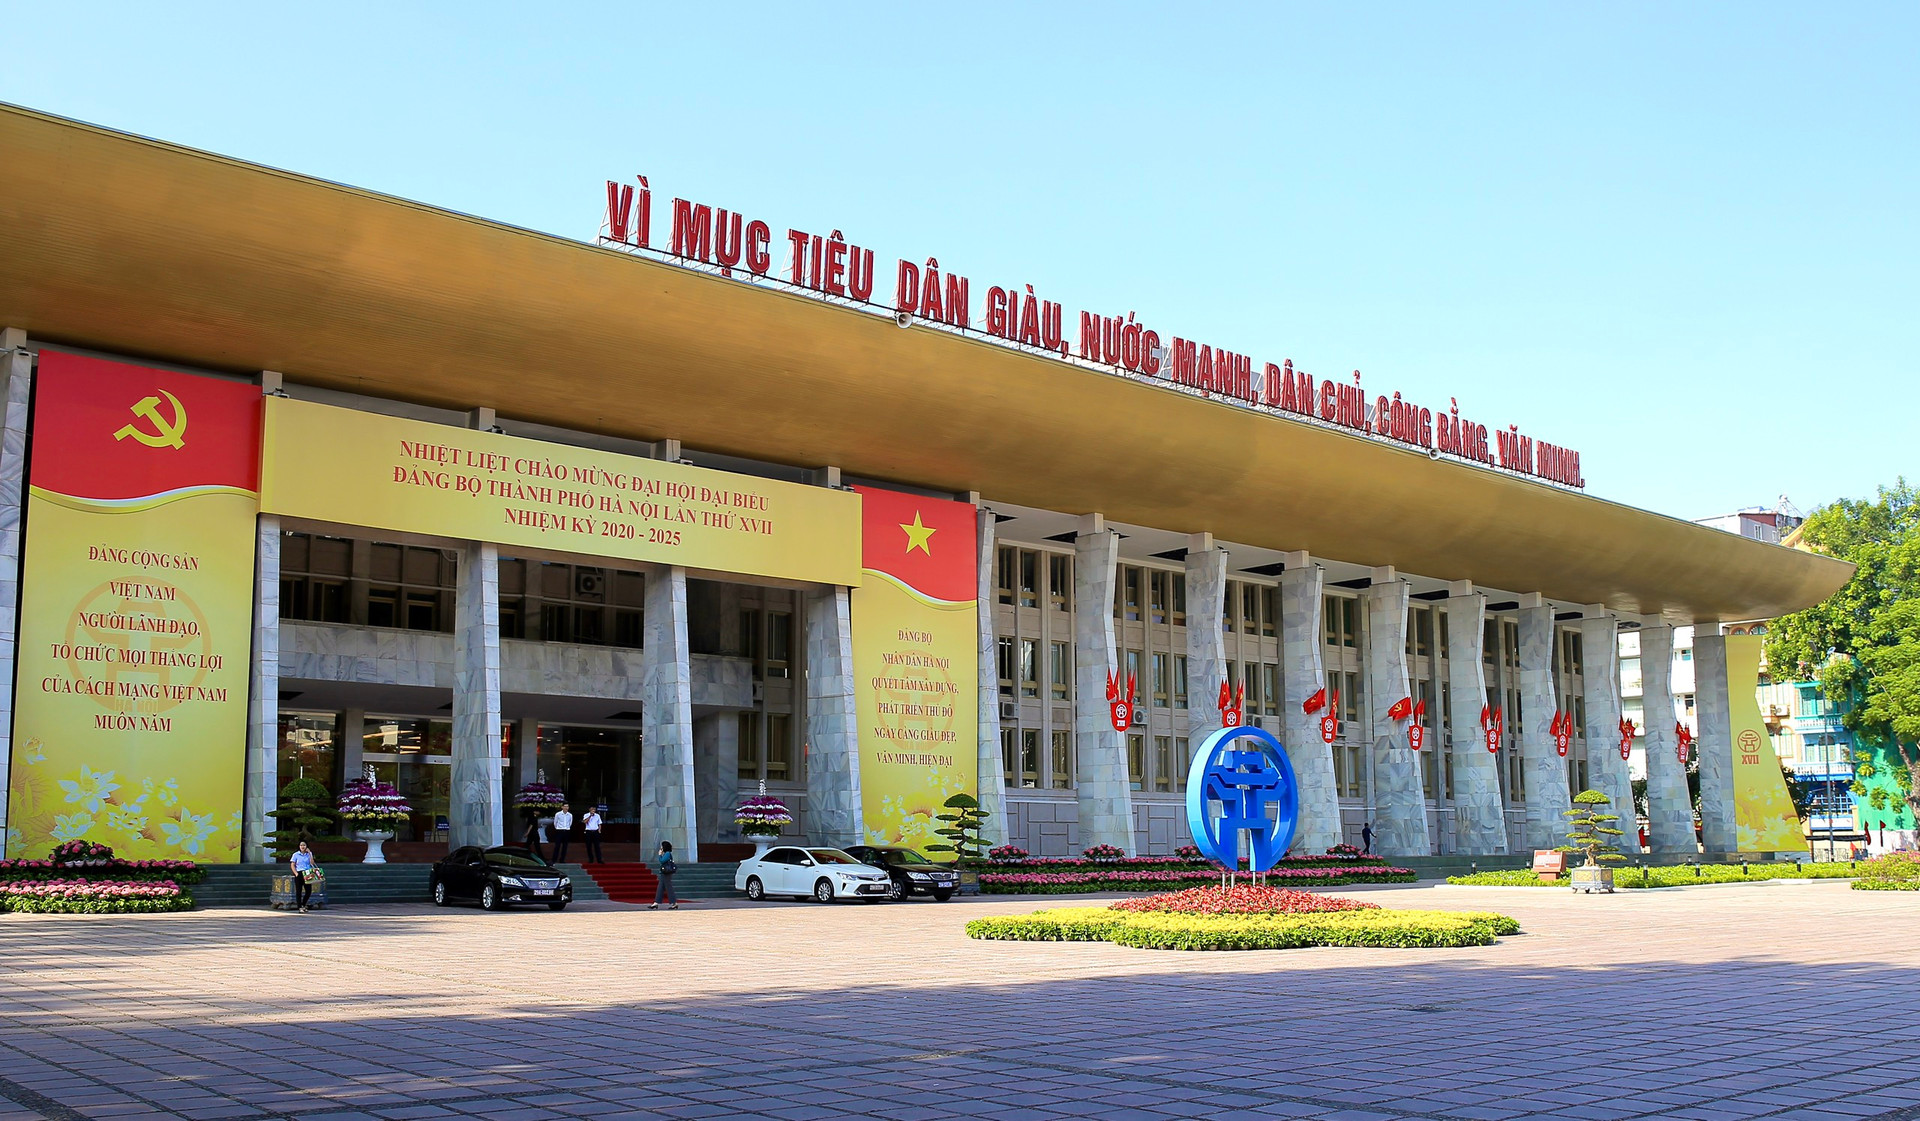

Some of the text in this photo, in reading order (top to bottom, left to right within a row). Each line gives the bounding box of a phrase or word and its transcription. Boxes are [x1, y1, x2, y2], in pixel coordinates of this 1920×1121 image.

[606, 175, 651, 248] VÌ
[672, 198, 770, 279] MỤC
[788, 229, 873, 301] TIÊU
[897, 257, 969, 327] DÂN
[986, 284, 1069, 359] GIÀU,
[1080, 311, 1160, 376] NƯỚC
[1171, 336, 1258, 406] MẠNH,
[1264, 359, 1314, 416] DÂN
[1320, 370, 1371, 436] CHỦ,
[1376, 391, 1432, 447] CÔNG
[1495, 424, 1533, 474] VĂN
[400, 440, 769, 512] NHIỆT LIỆT CHÀO MỪNG ĐẠI HỘI ĐẠI BIỂU
[393, 463, 772, 535] ĐẢNG BỘ THÀNH PHỐ HÀ NỘI LẦN THỨ XVII
[504, 507, 566, 532] NHIỆM
[571, 512, 597, 535] KỲ
[601, 521, 635, 540] 2020
[648, 528, 681, 546] 2025
[89, 543, 198, 570] ĐẢNG CỘNG SẢN
[110, 581, 175, 602] VIỆT NAM
[79, 612, 200, 638] NGƯỜI LÃNH ĐẠO,
[74, 643, 116, 663] CHỨC
[118, 649, 145, 666] MỌI
[200, 655, 223, 672] LỢI
[42, 674, 227, 703] CỦA CÁCH MẠNG VIỆT NAM
[94, 711, 171, 732] MUÔN NĂM
[1741, 755, 1760, 765] XVII
